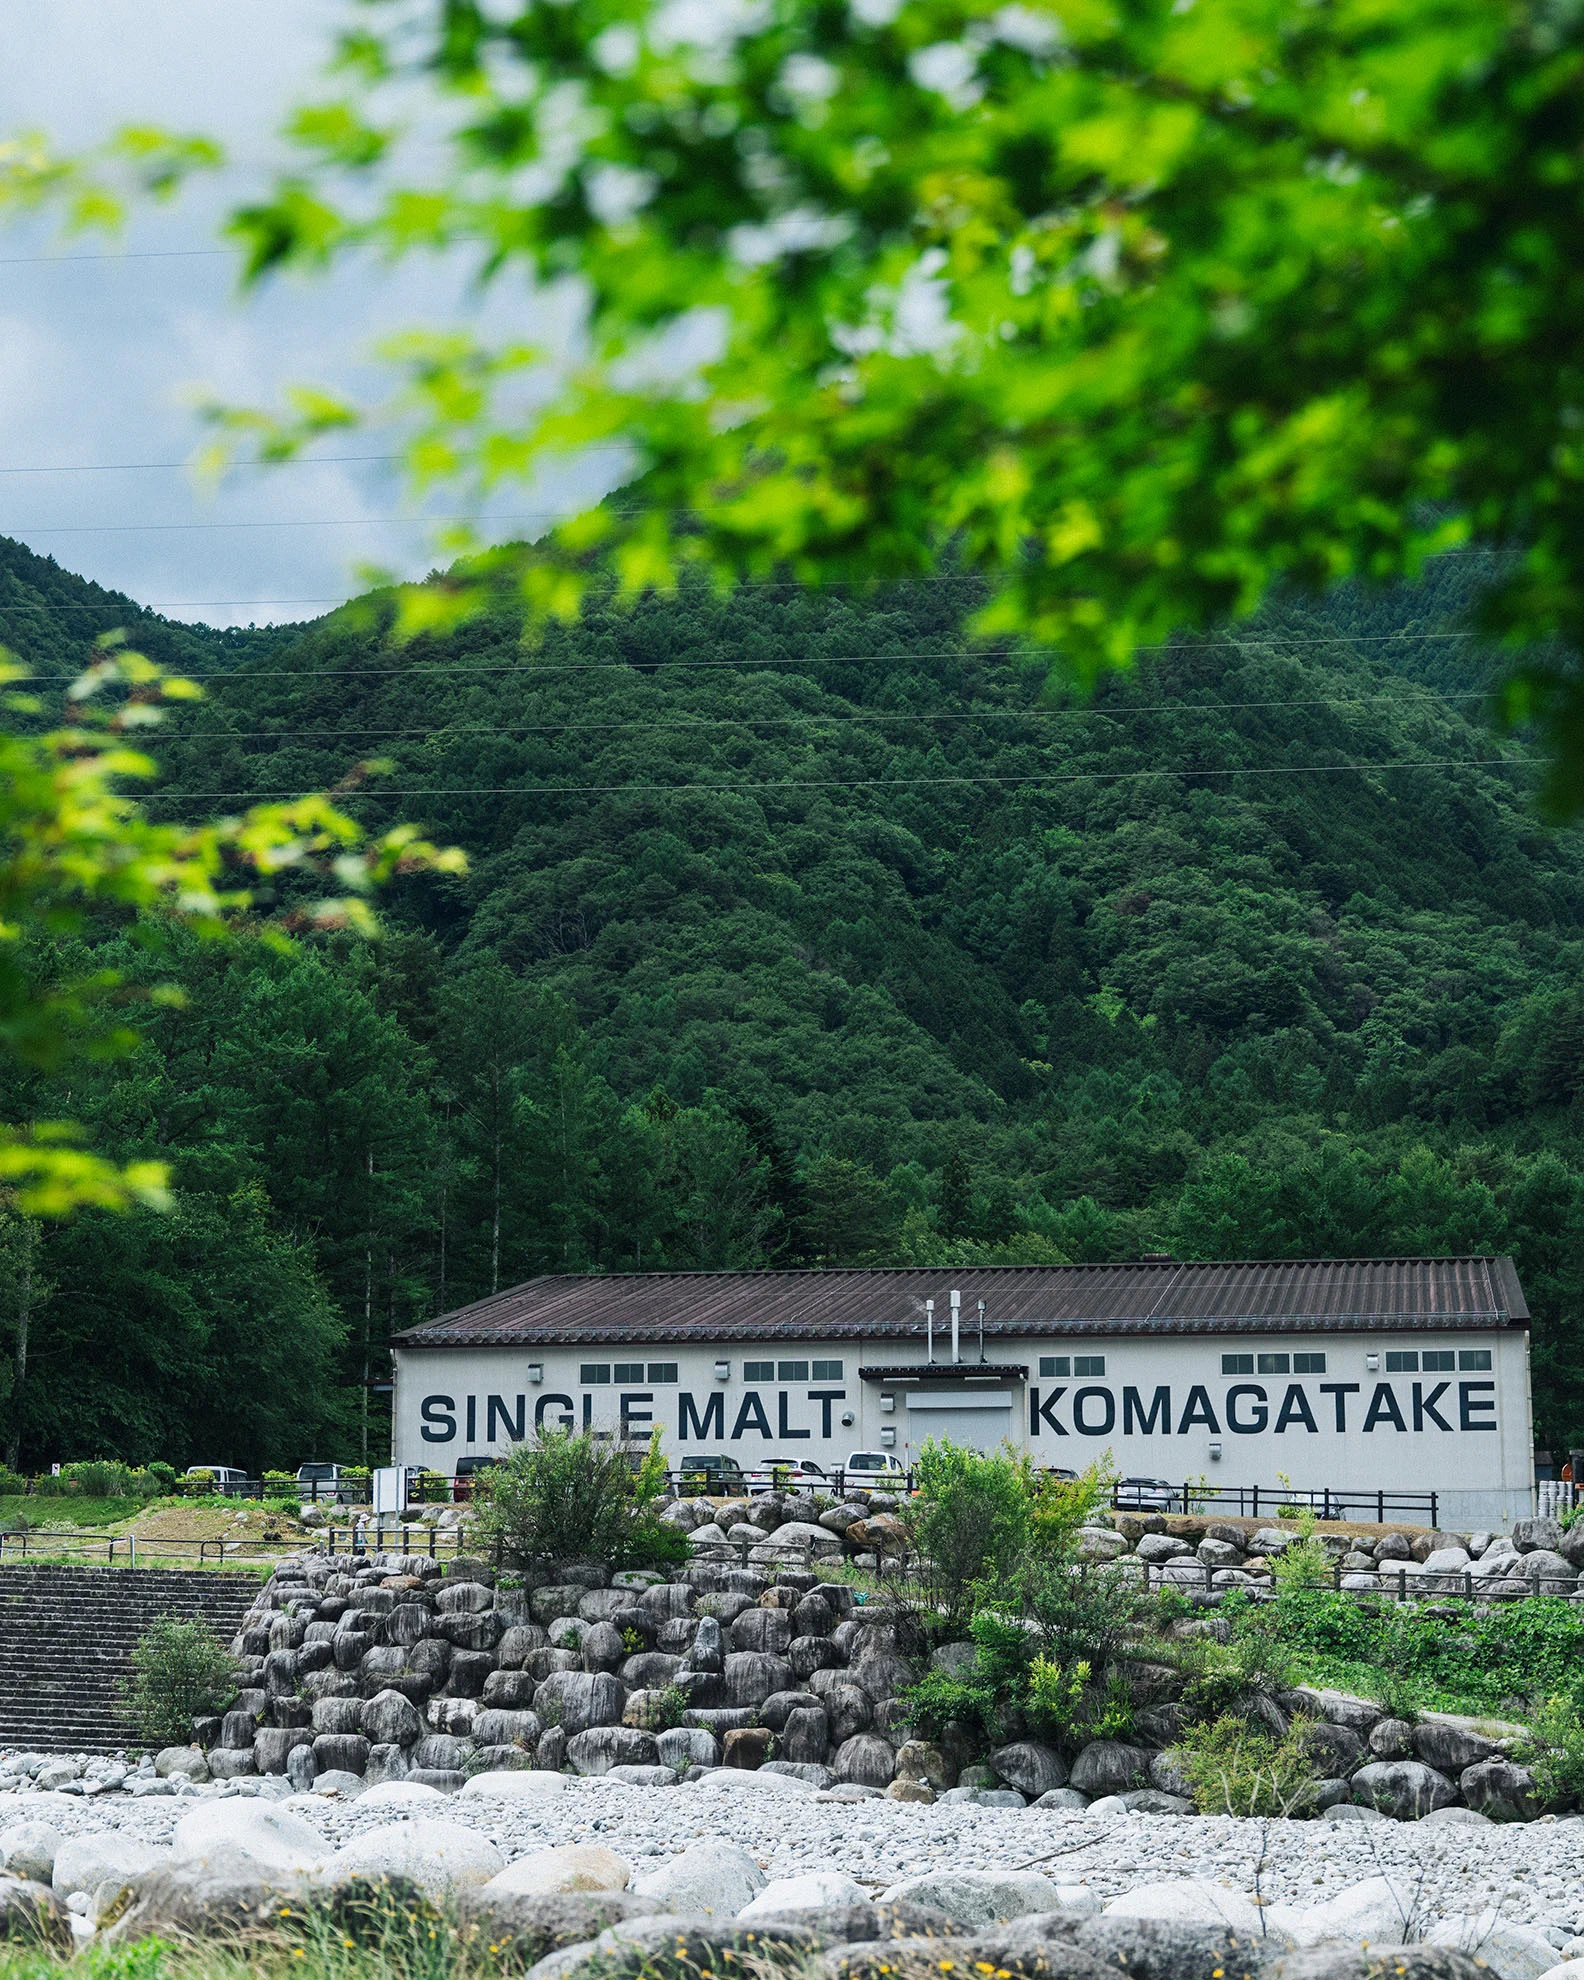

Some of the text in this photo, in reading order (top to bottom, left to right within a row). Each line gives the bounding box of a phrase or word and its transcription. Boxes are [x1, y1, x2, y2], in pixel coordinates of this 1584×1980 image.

[420, 1381, 1498, 1443] SINGLE MALT KOMAGATAKE
